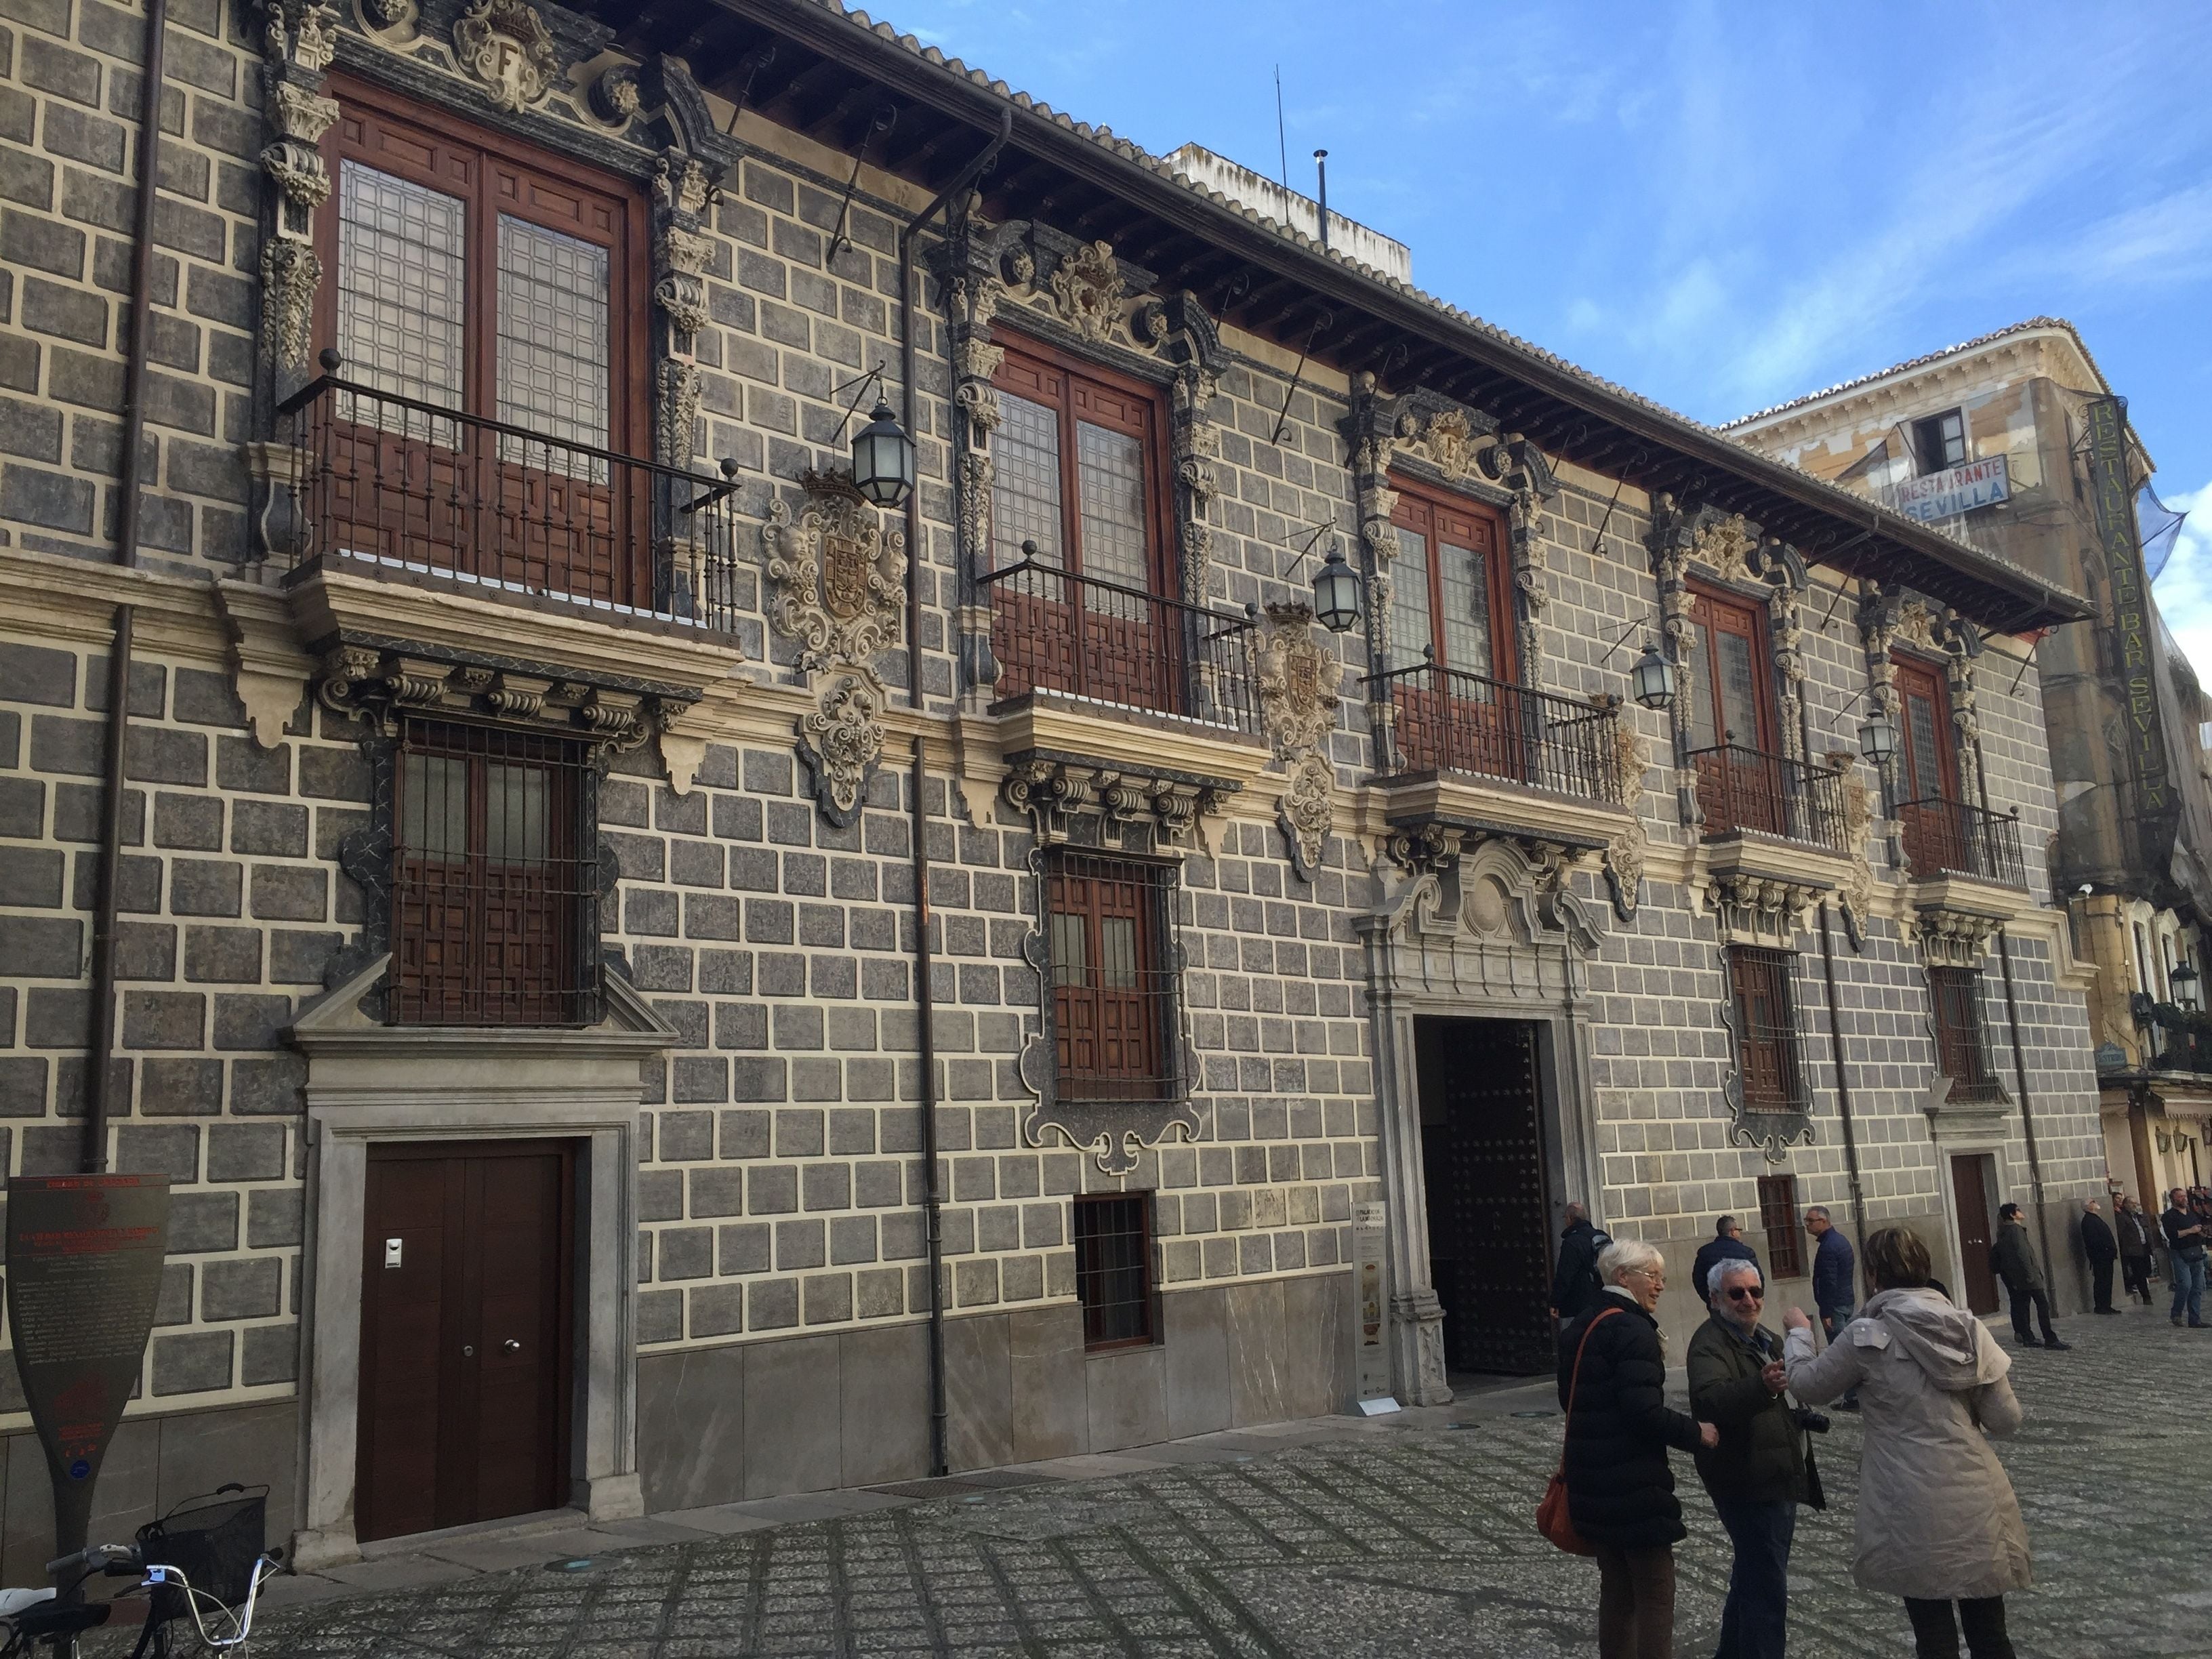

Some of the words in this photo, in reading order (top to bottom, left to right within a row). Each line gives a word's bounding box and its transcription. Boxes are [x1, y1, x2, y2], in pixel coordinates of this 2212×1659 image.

[498, 42, 518, 75] F
[1906, 482, 2005, 522] SEVILLA
[2093, 404, 2137, 605] RESTAURANTE
[2120, 613, 2145, 668] BAR
[2129, 677, 2165, 810] SEVILLA
